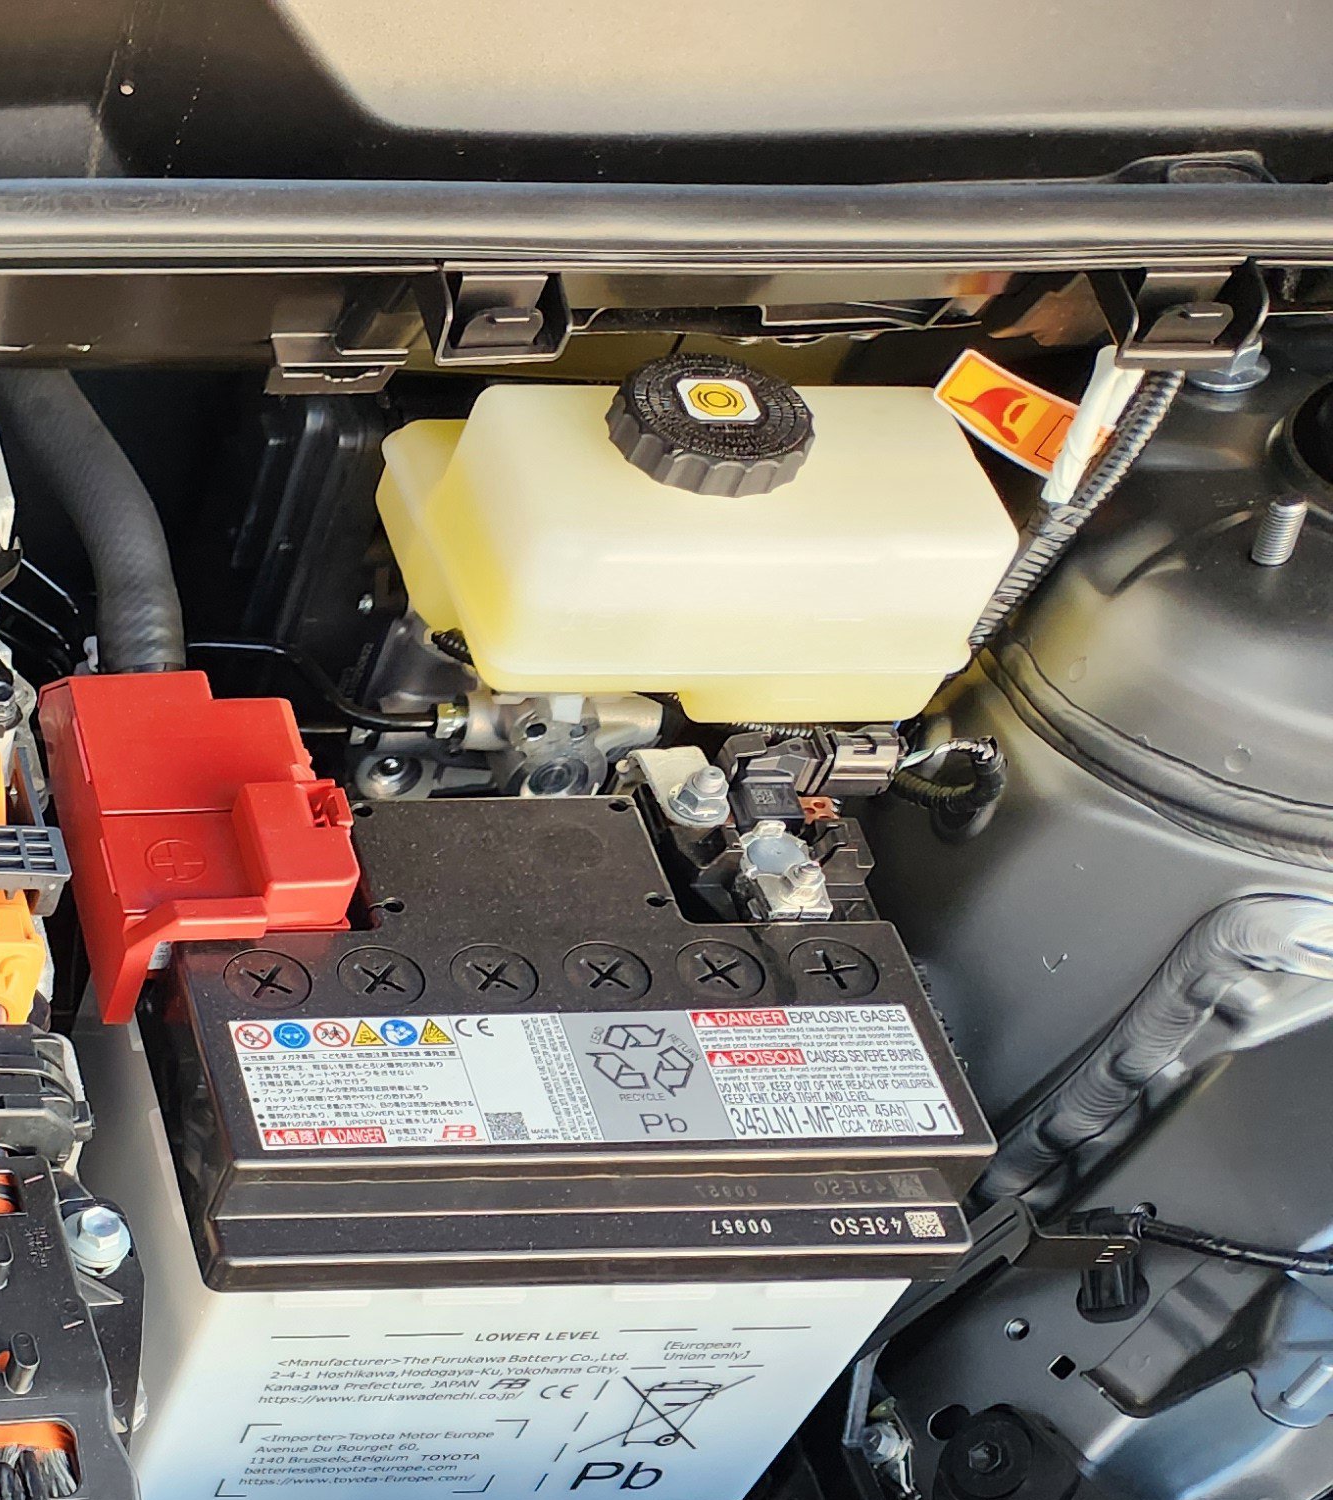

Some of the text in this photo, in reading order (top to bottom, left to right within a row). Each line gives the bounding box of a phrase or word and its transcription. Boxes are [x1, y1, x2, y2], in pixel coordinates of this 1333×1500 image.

[714, 1009, 906, 1026] DANGER EXPLOSIVE GASES
[667, 1033, 702, 1062] RETURN
[731, 1049, 924, 1065] POISON CAUSES SEVERE BURNS
[718, 1082, 731, 1093] DO
[733, 1082, 752, 1092] NOT
[770, 1081, 791, 1091] KEEP
[794, 1081, 811, 1091] OUT
[814, 1081, 826, 1090] OF
[828, 1081, 845, 1090] THE
[846, 1080, 876, 1090] REACH
[878, 1080, 889, 1089] OF
[619, 1093, 666, 1101] RECYCLE
[722, 1094, 744, 1104] KEEP
[746, 1093, 770, 1103] VENT
[772, 1093, 796, 1103] CAPS
[796, 1092, 823, 1102] TIGHT
[825, 1091, 843, 1102] AND
[639, 1113, 688, 1134] Pb
[730, 1106, 834, 1135] 345LN1-MF
[835, 1104, 869, 1118] 20HR
[875, 1103, 906, 1117] 45Ah
[841, 1120, 865, 1133] CCA
[339, 1128, 384, 1143] DANGER
[475, 1331, 601, 1342] LOWER LEVEL
[432, 1355, 506, 1365] Furukawa
[508, 1354, 568, 1364] Battery
[663, 1352, 706, 1361] Union
[270, 1372, 310, 1380] 2-4-1
[264, 1380, 480, 1393] Kanagawa Prefecture, JAPAN
[399, 1431, 441, 1440] Motor
[443, 1430, 495, 1440] Europe
[255, 1444, 310, 1453] Avenue
[313, 1444, 332, 1452] Du
[337, 1443, 395, 1454] Bourget
[250, 1456, 285, 1465] 1140
[421, 1453, 481, 1461] TOYOTA
[244, 1463, 458, 1475] batteries@toyota-europe.com
[569, 1461, 664, 1490] Pb
